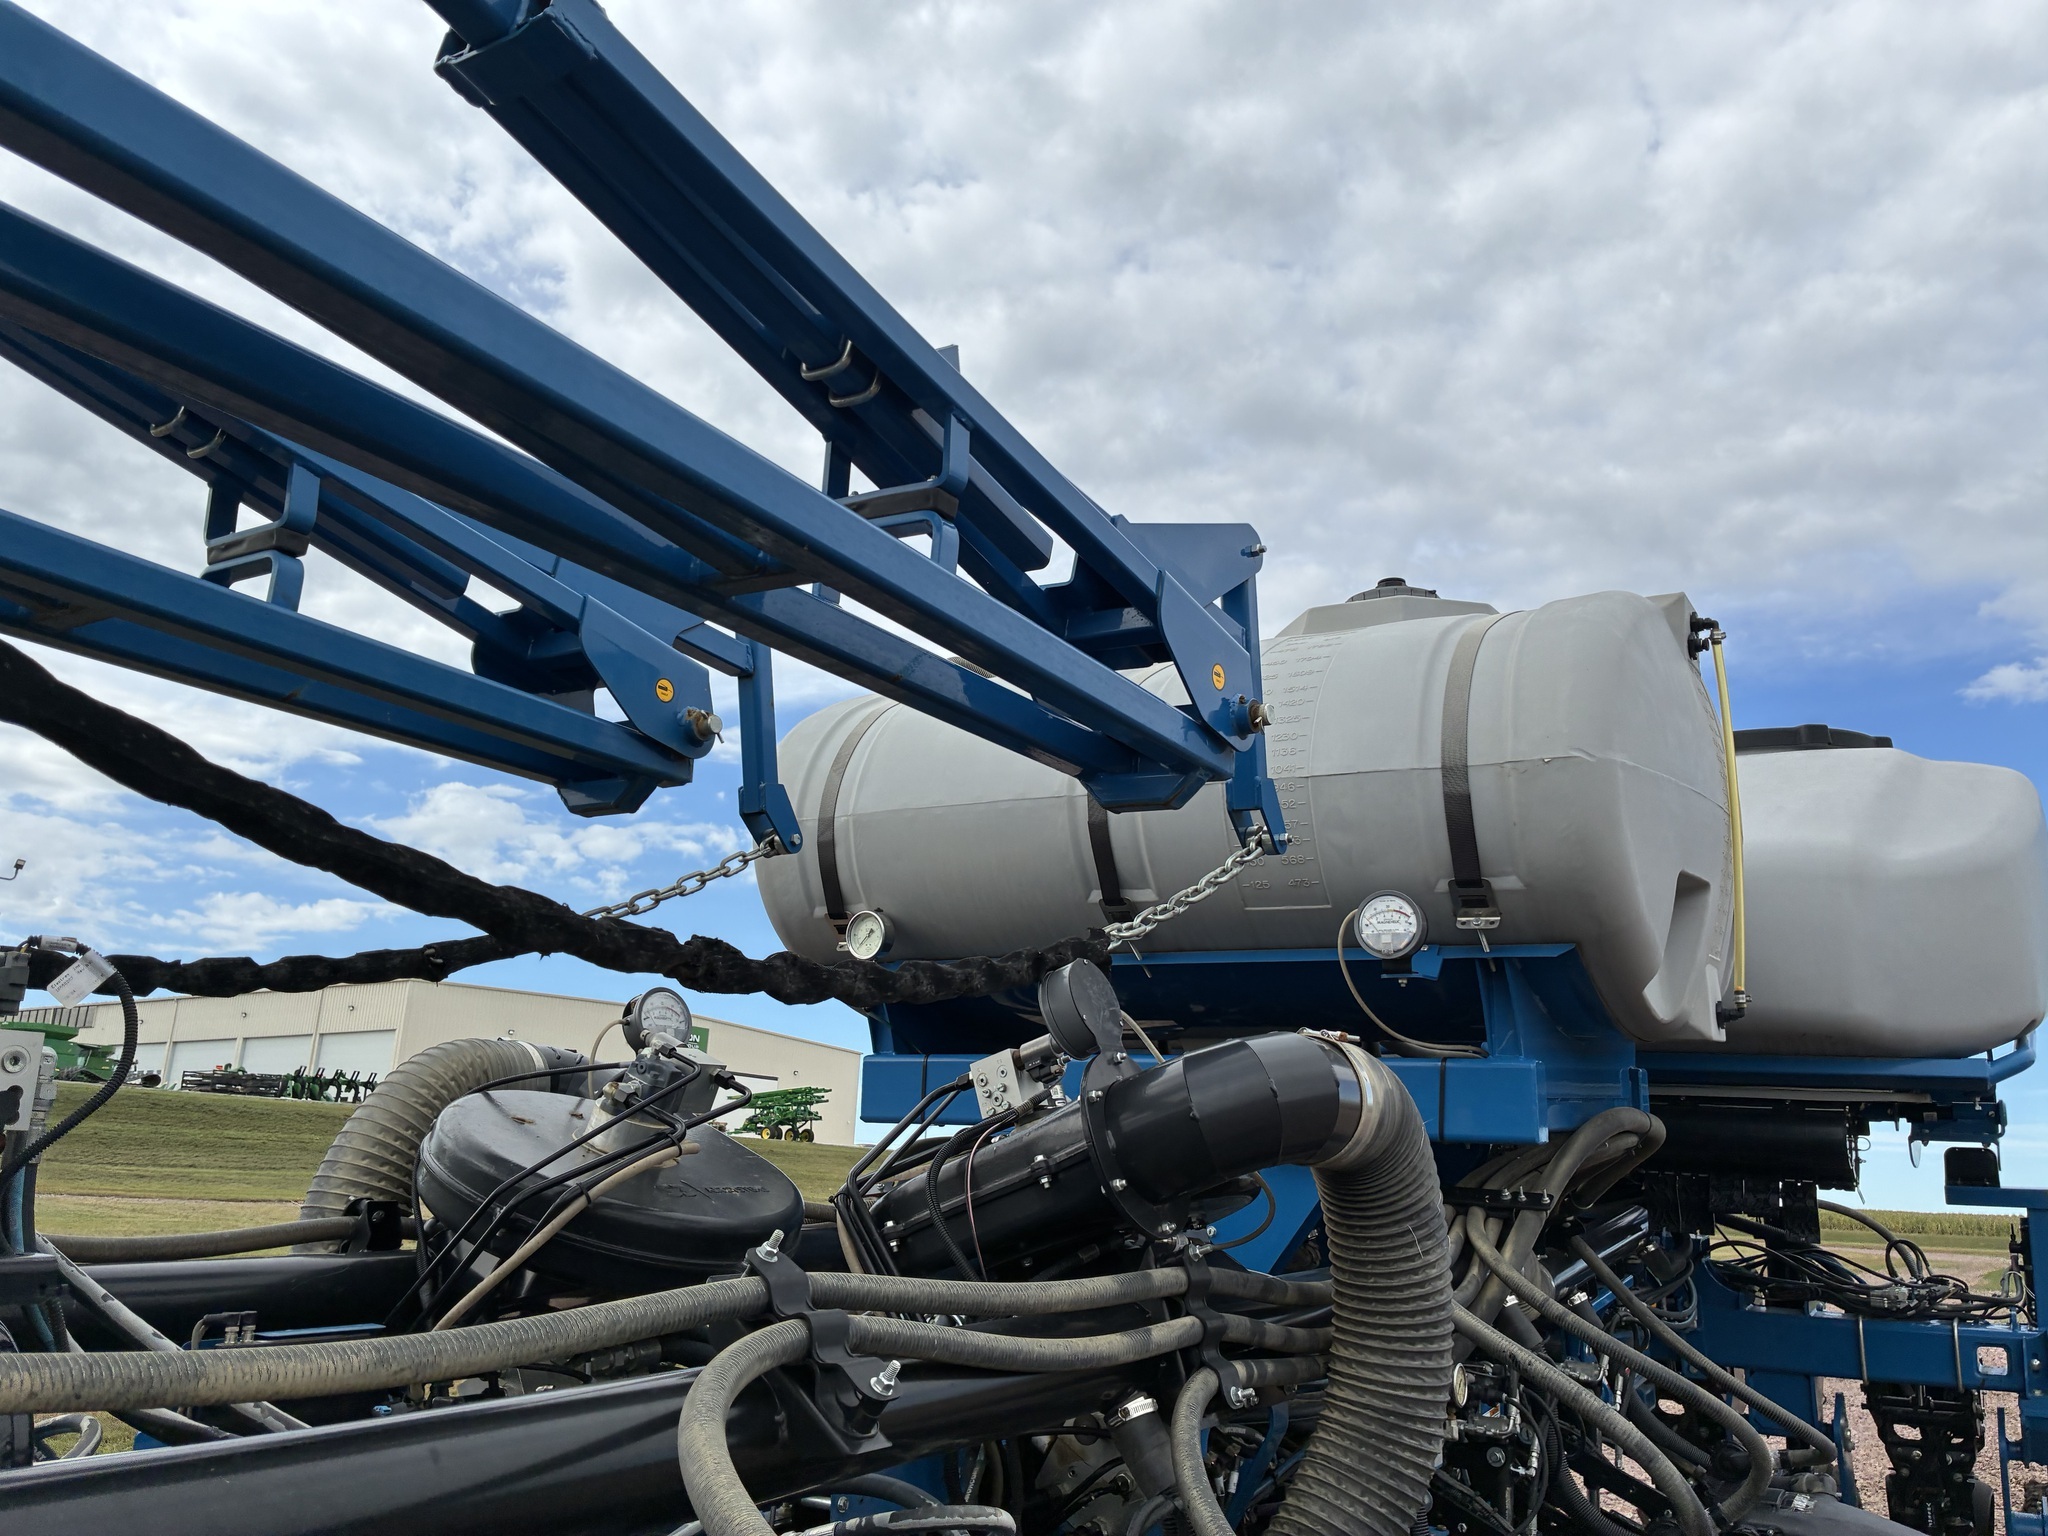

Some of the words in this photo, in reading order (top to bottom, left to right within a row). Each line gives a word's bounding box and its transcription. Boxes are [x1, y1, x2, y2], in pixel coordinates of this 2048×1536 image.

[1279, 699, 1305, 708] 1420
[1274, 715, 1301, 725] 1325
[1271, 732, 1299, 742] 1230
[1271, 748, 1297, 757] 1136
[1271, 764, 1297, 774] 1041
[1281, 799, 1297, 809] 52
[1284, 820, 1299, 830] 57
[1281, 855, 1305, 865] 568
[1250, 880, 1271, 889] 125
[1288, 878, 1311, 887] 473
